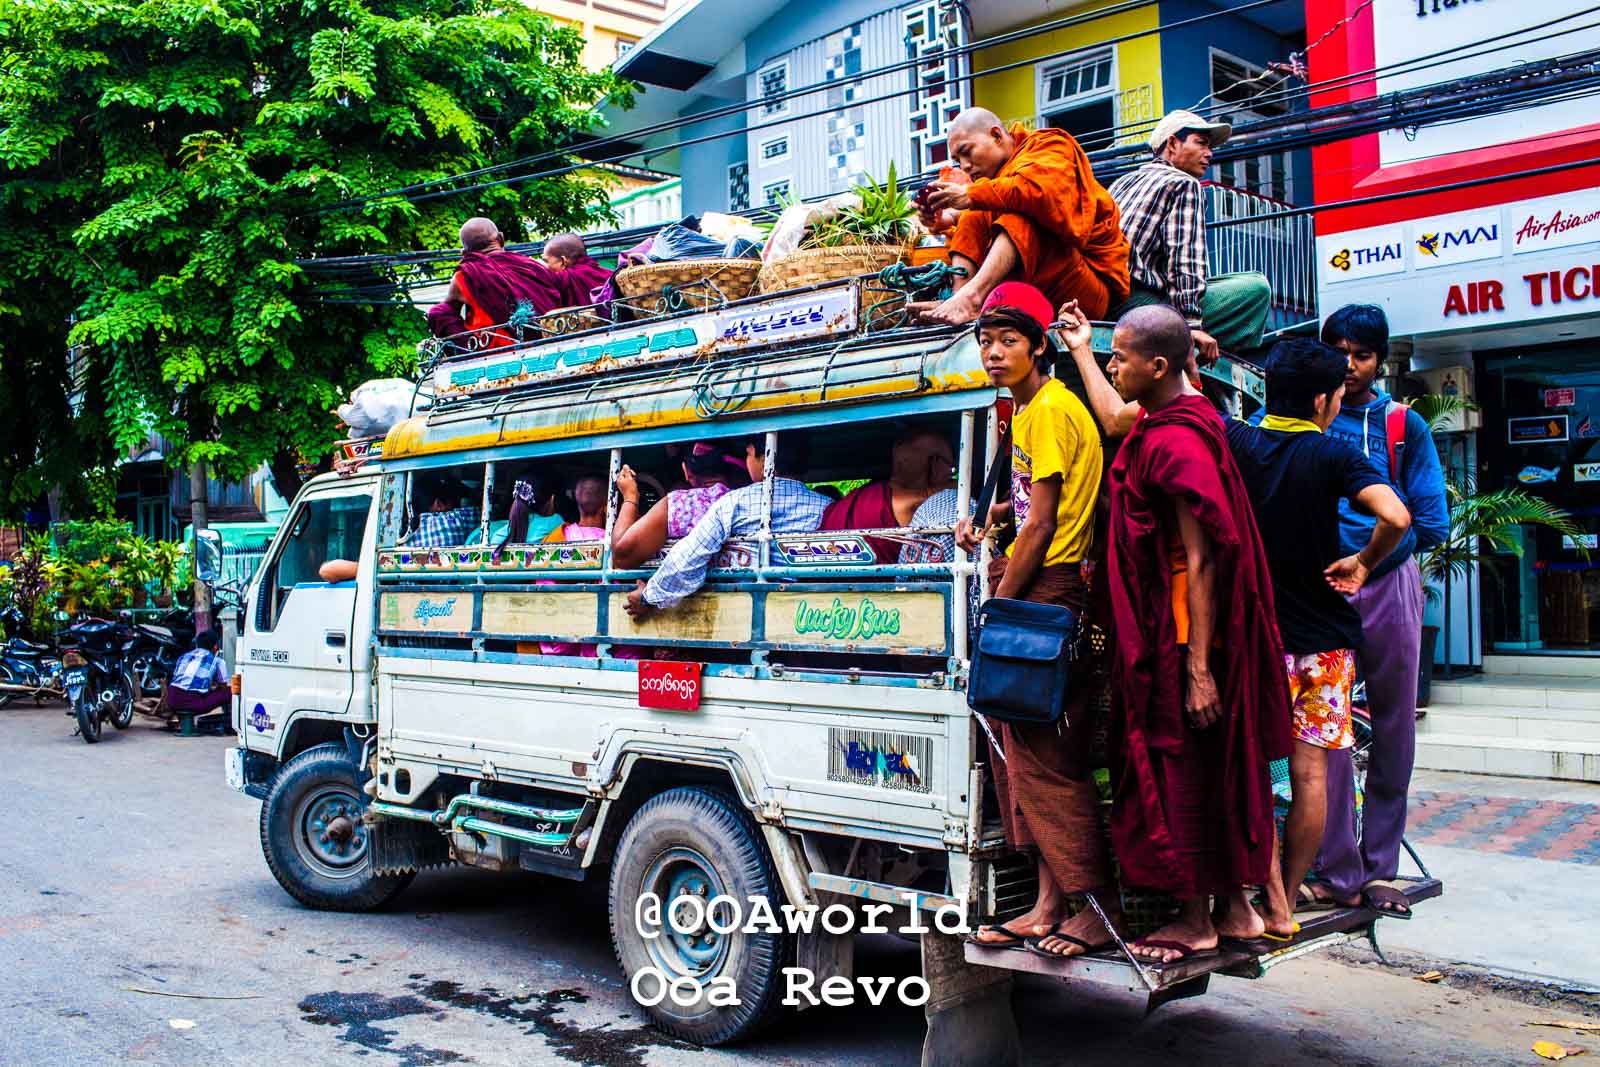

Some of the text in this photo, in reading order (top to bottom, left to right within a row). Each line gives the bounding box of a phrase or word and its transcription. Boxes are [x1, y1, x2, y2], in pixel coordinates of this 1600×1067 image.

[1443, 224, 1498, 249] MAI
[1353, 243, 1402, 265] THAI
[1443, 280, 1505, 317] AIR
[794, 598, 900, 640] Lucky Bus
